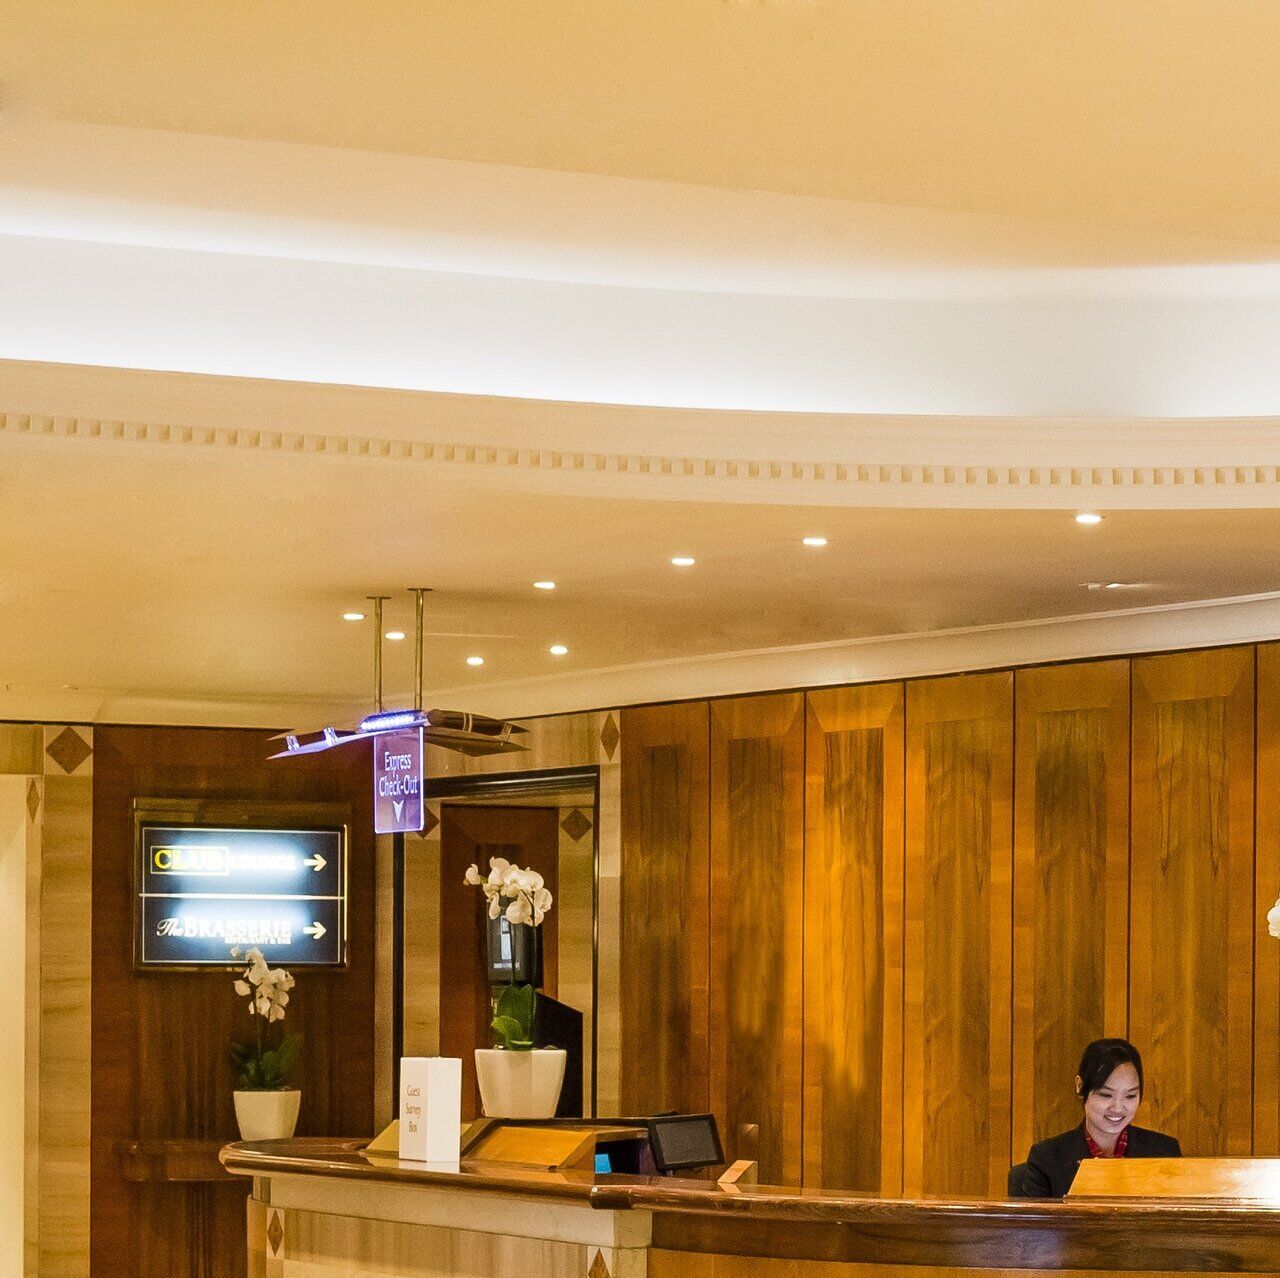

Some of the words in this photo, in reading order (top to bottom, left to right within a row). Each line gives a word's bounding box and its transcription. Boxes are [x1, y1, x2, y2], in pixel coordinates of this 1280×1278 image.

[384, 751, 412, 778] Express
[379, 774, 418, 797] Check-Out
[154, 849, 224, 870] CLUB
[156, 917, 184, 938] The
[183, 916, 292, 938] BRASSERIE
[406, 1084, 421, 1097] Guest
[408, 1120, 418, 1133] Box
